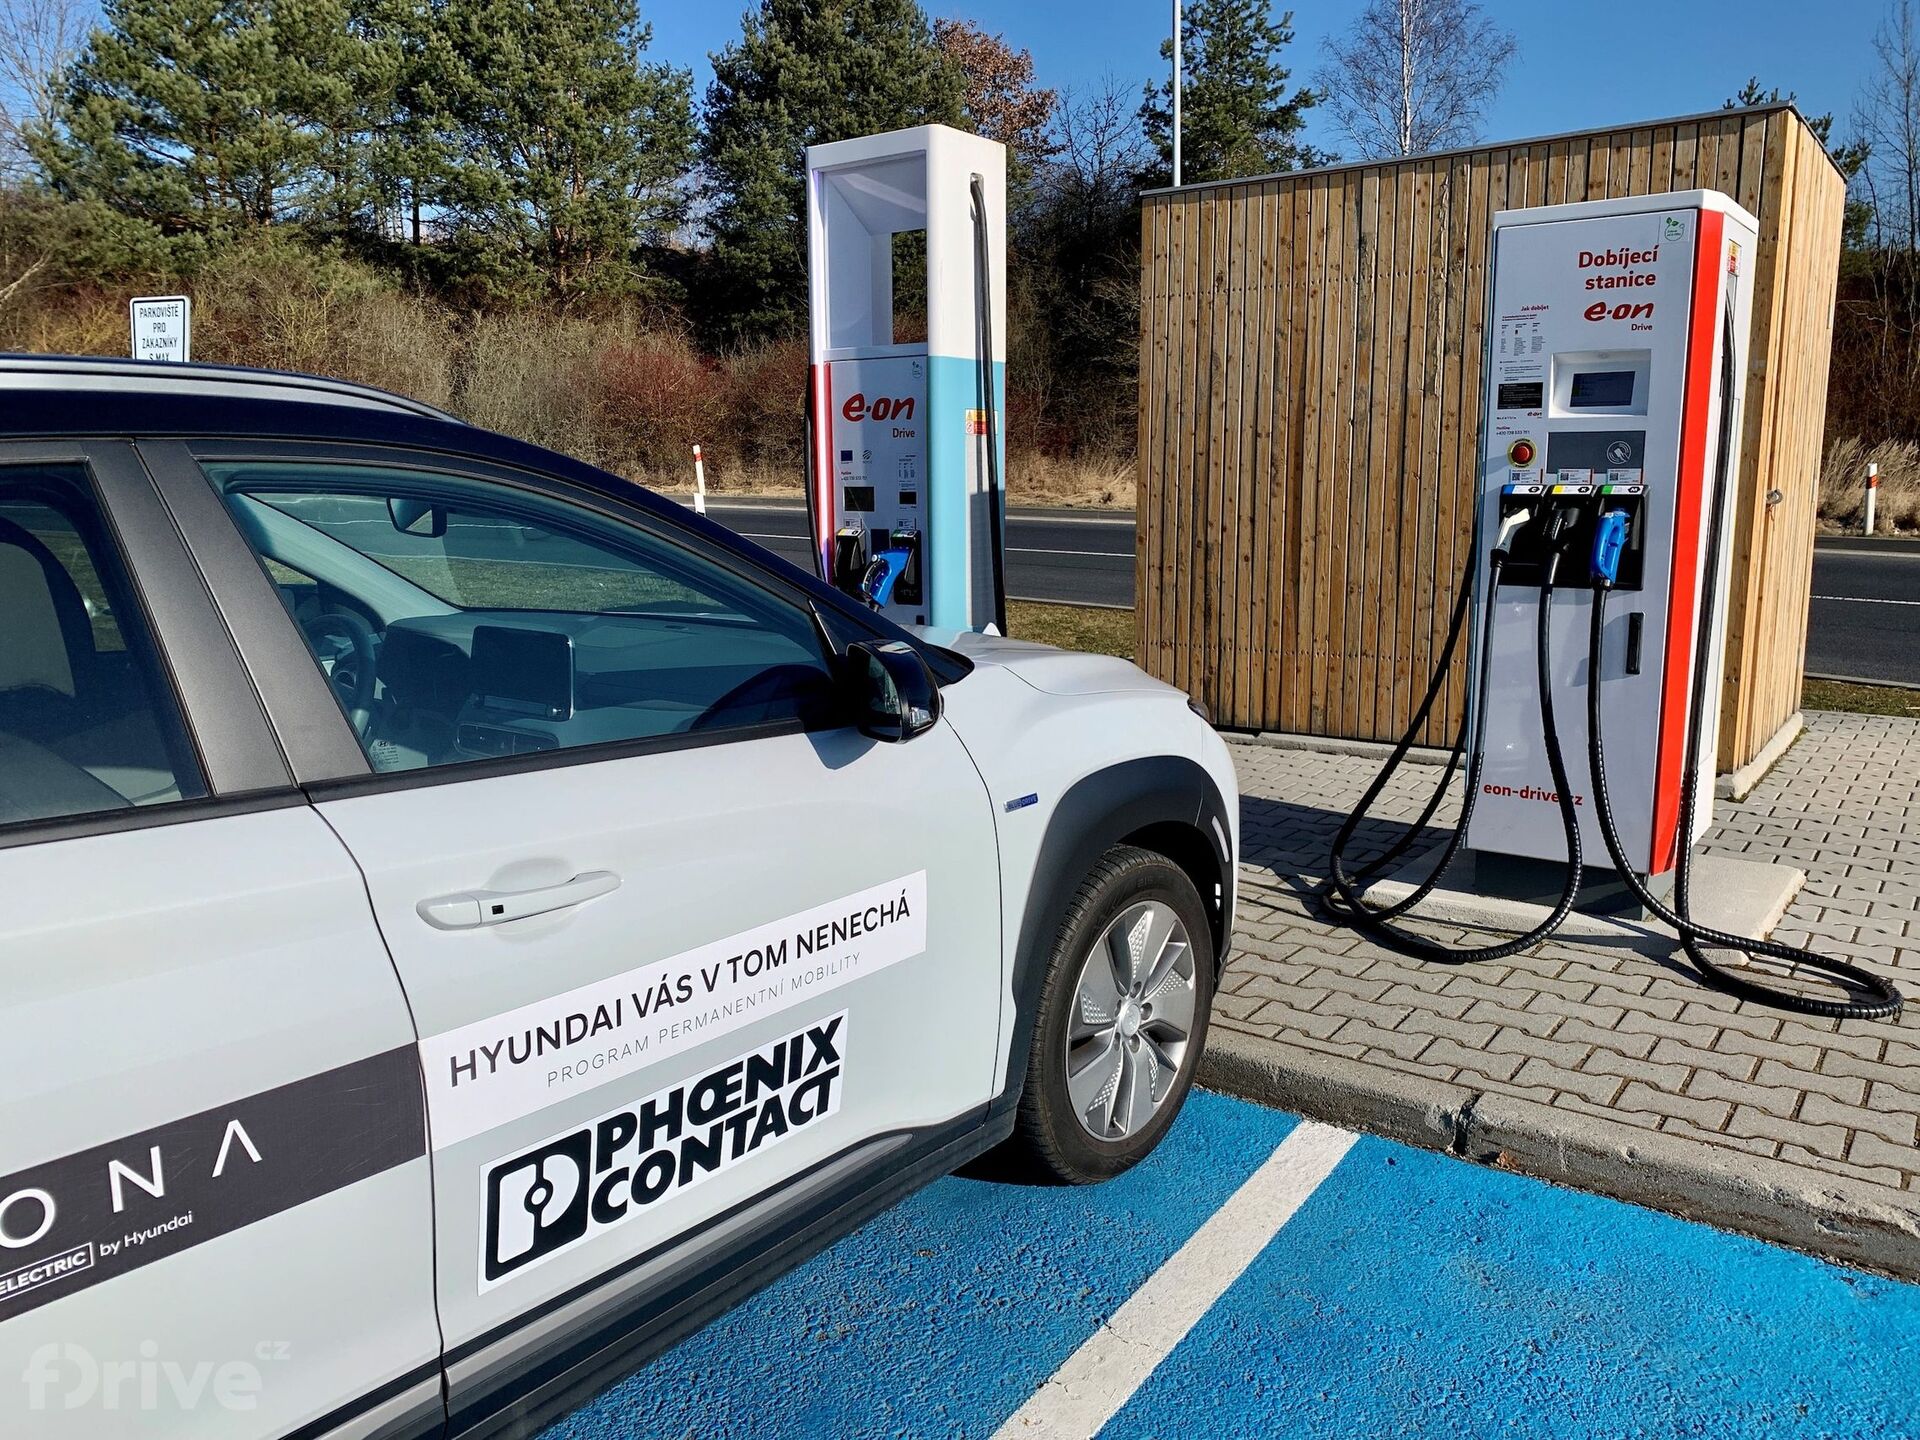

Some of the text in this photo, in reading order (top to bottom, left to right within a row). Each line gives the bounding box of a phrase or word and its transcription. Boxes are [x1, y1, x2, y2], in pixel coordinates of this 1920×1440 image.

[1579, 245, 1659, 268] Dobíjecí
[1585, 270, 1656, 290] stanice
[140, 304, 178, 317] PARKOVIŠTĚ
[153, 322, 166, 332] PRO
[1631, 323, 1653, 331] Drive
[142, 336, 177, 349] ZÁKAZNÍKY
[892, 428, 915, 438] Drive
[1483, 784, 1583, 806] eon-drivez
[449, 888, 910, 1087] HYUNDAI VÁS V TOM NENECHÁ
[547, 951, 861, 1088] PROGRAM PERMANENTNÍ MOBILITY
[591, 1064, 840, 1224] CONTACT
[0, 1211, 193, 1296] ELECTRIC by Hyundai
